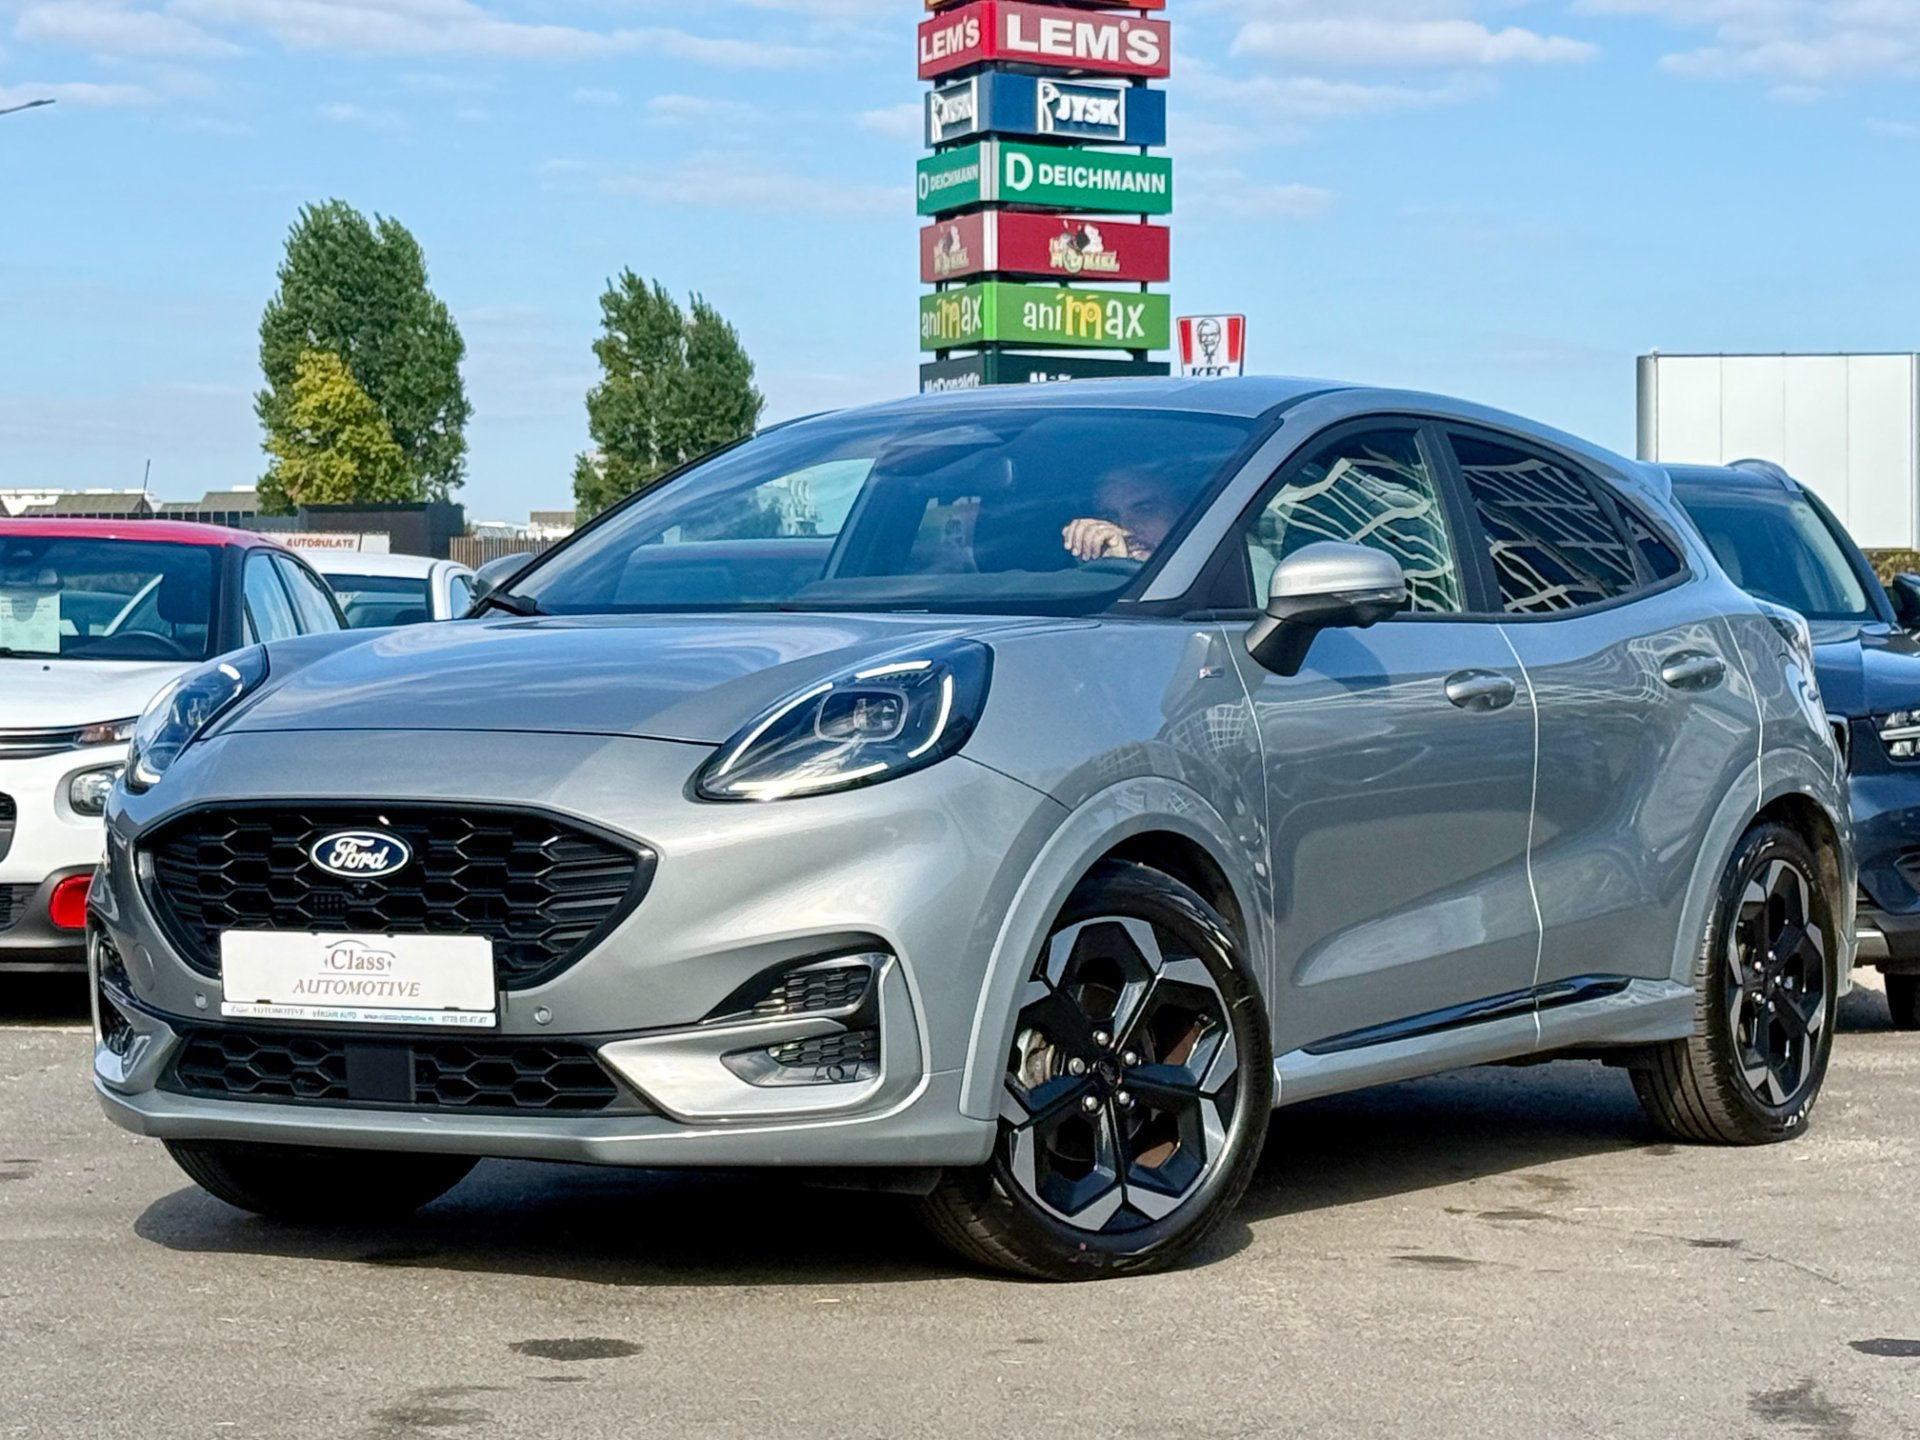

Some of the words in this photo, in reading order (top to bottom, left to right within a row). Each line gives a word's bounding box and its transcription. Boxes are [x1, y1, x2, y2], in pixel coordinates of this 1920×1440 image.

[920, 17, 980, 64] LEM'S
[1007, 14, 1160, 65] LEM'S
[1055, 95, 1119, 126] JYSK
[930, 164, 978, 191] DEICHMANN
[1039, 163, 1166, 194] DEICHMANN
[922, 294, 982, 339] animax
[1023, 293, 1145, 340] animax
[286, 538, 355, 548] AUTORULATE
[328, 837, 389, 870] Ford
[330, 950, 386, 971] Class
[292, 979, 421, 997] AUTOMOTIVE
